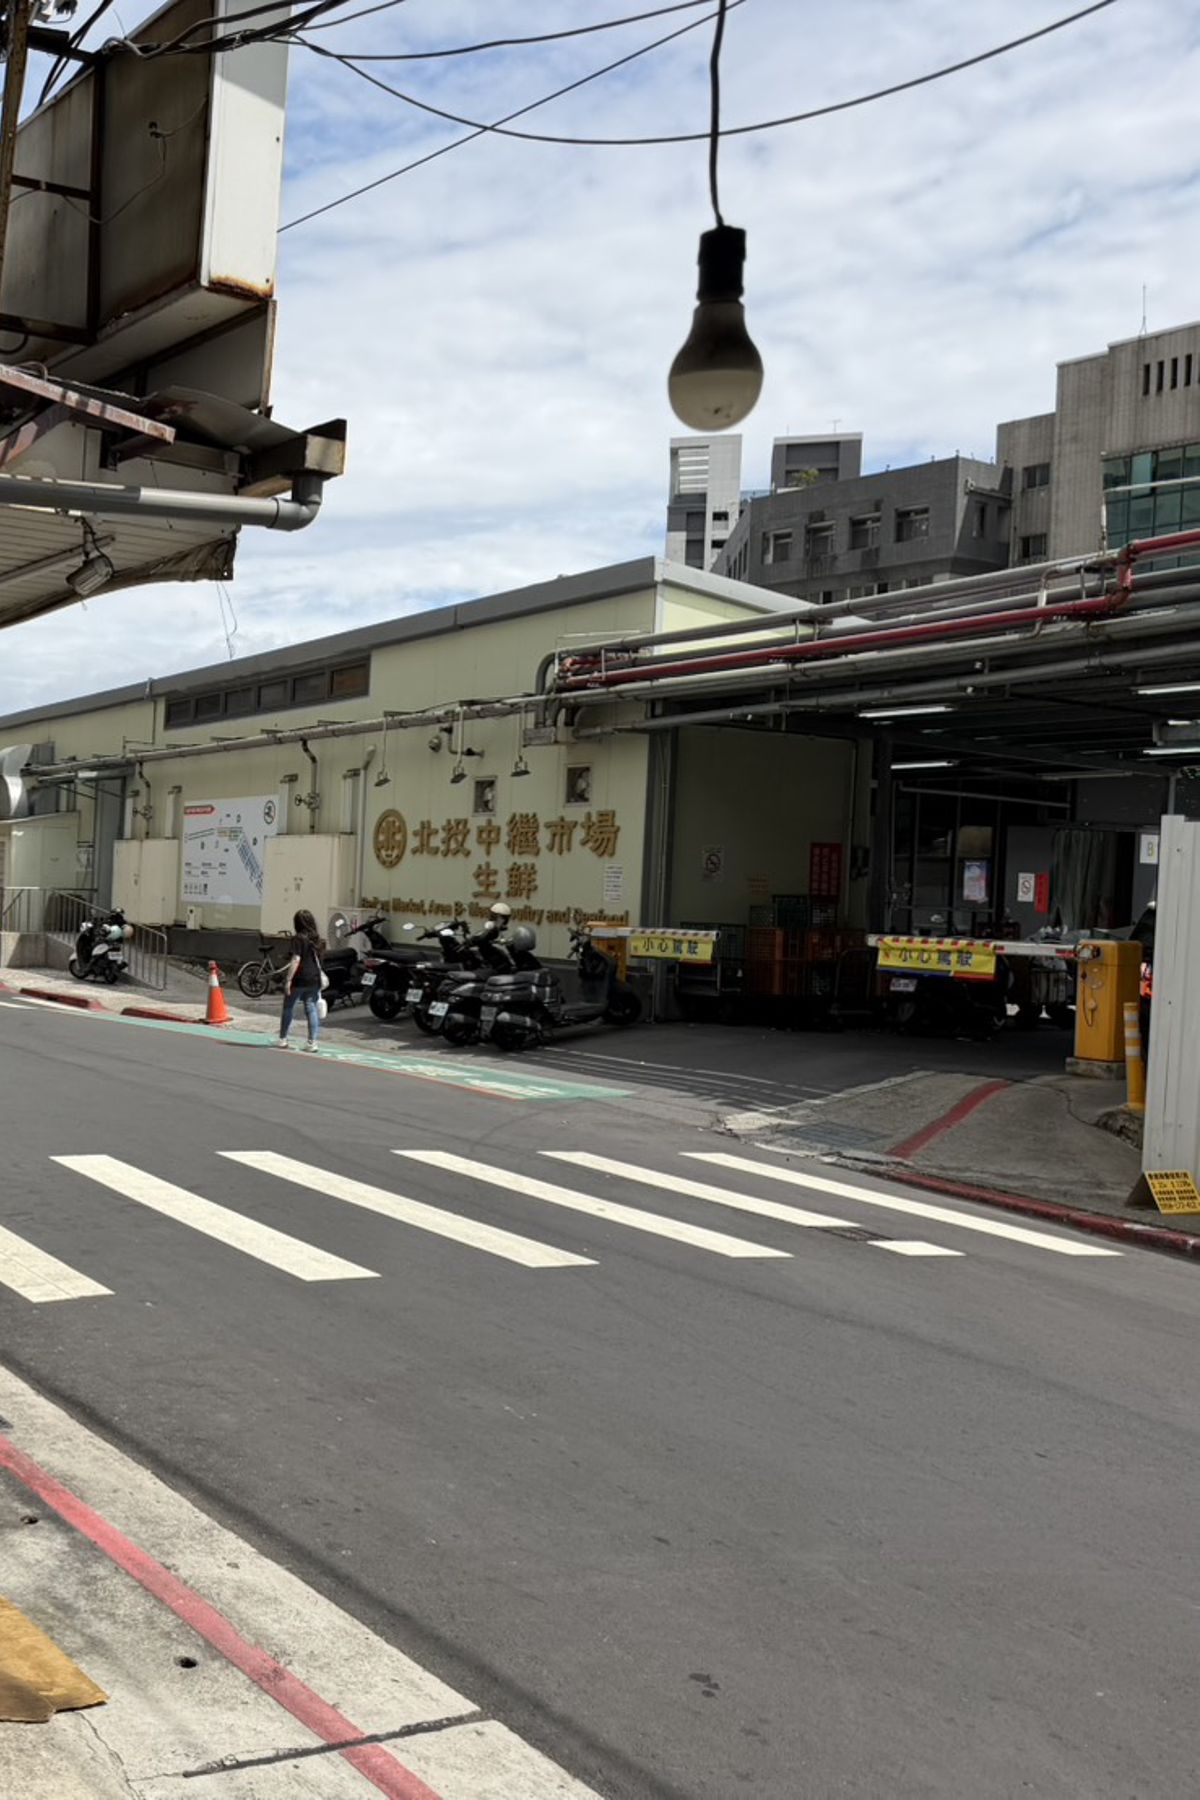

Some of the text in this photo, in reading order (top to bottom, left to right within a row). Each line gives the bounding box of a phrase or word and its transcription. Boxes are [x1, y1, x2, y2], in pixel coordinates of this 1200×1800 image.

[410, 809, 620, 857] 北投中繼市場
[471, 861, 540, 899] 生鮮
[546, 907, 570, 923] and
